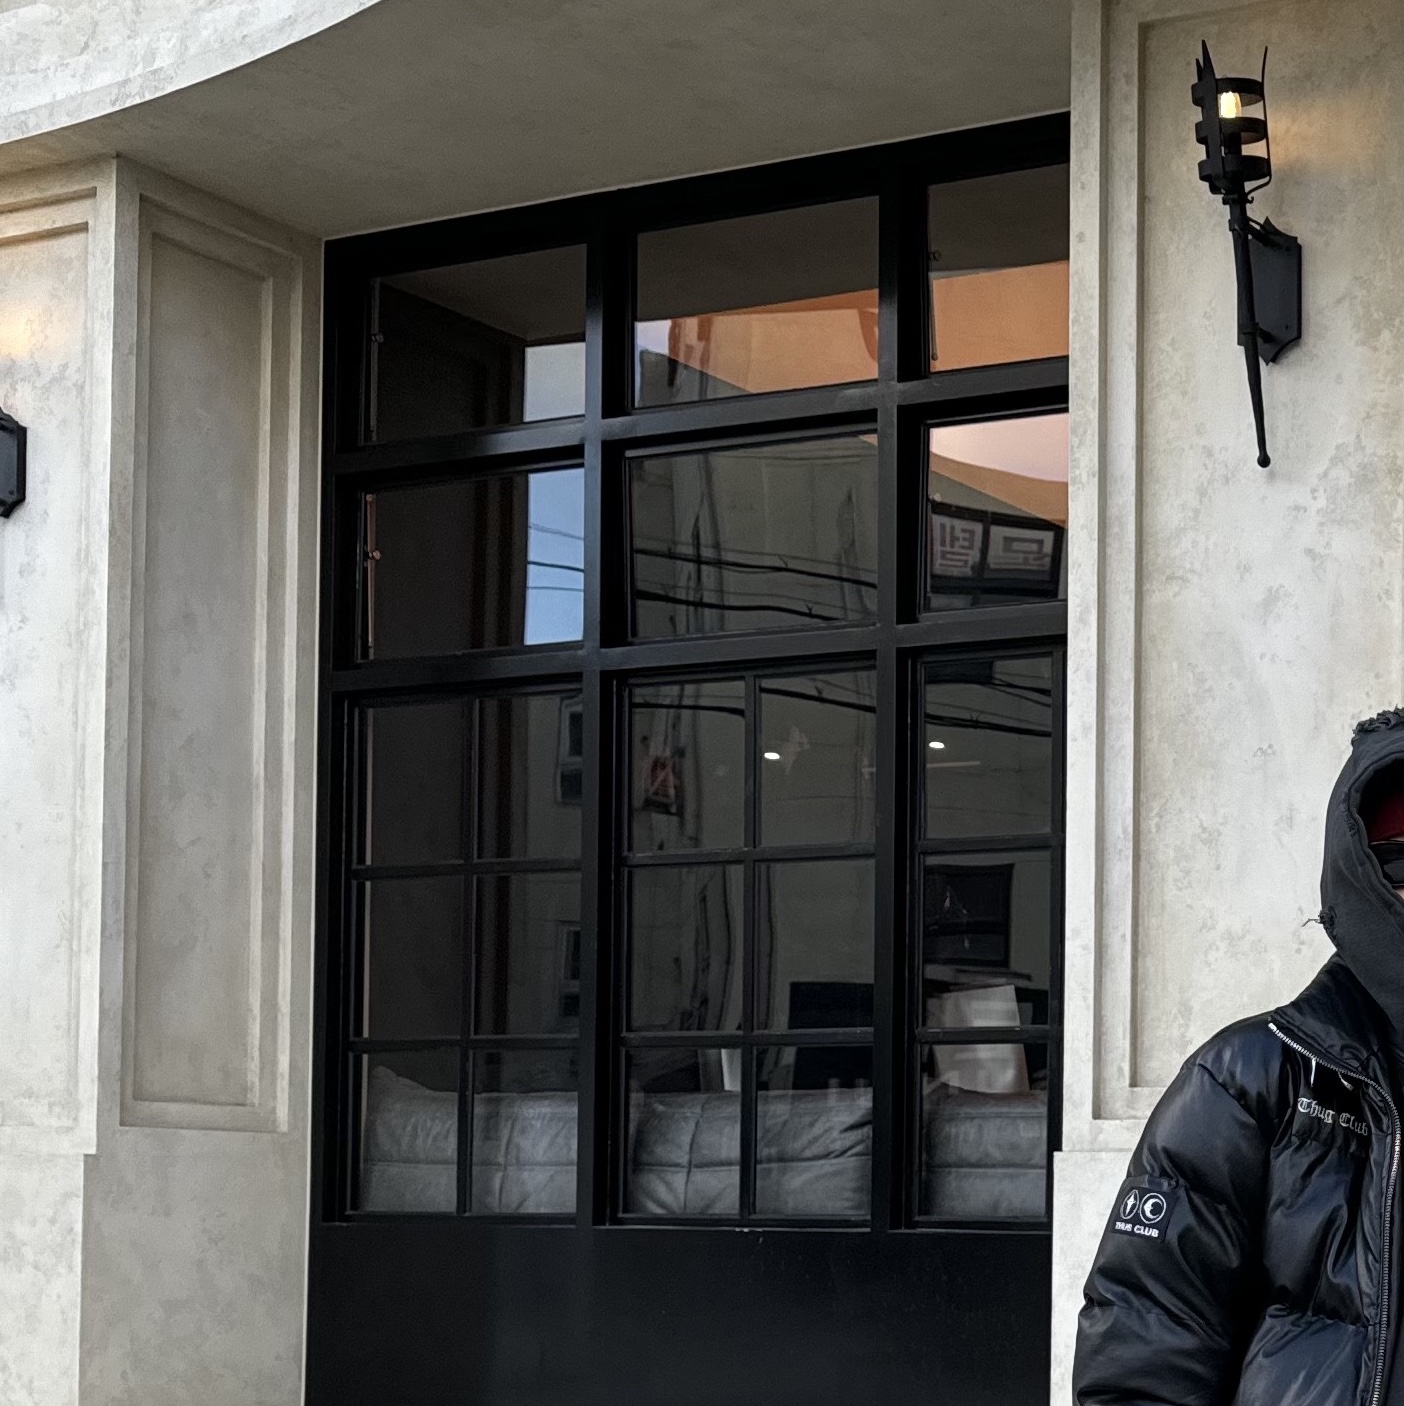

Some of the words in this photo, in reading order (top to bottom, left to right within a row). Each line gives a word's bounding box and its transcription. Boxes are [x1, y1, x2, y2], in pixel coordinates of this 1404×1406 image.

[1297, 1097, 1336, 1124] Thug
[1339, 1112, 1368, 1136] Club
[1133, 1224, 1160, 1238] CLUB
